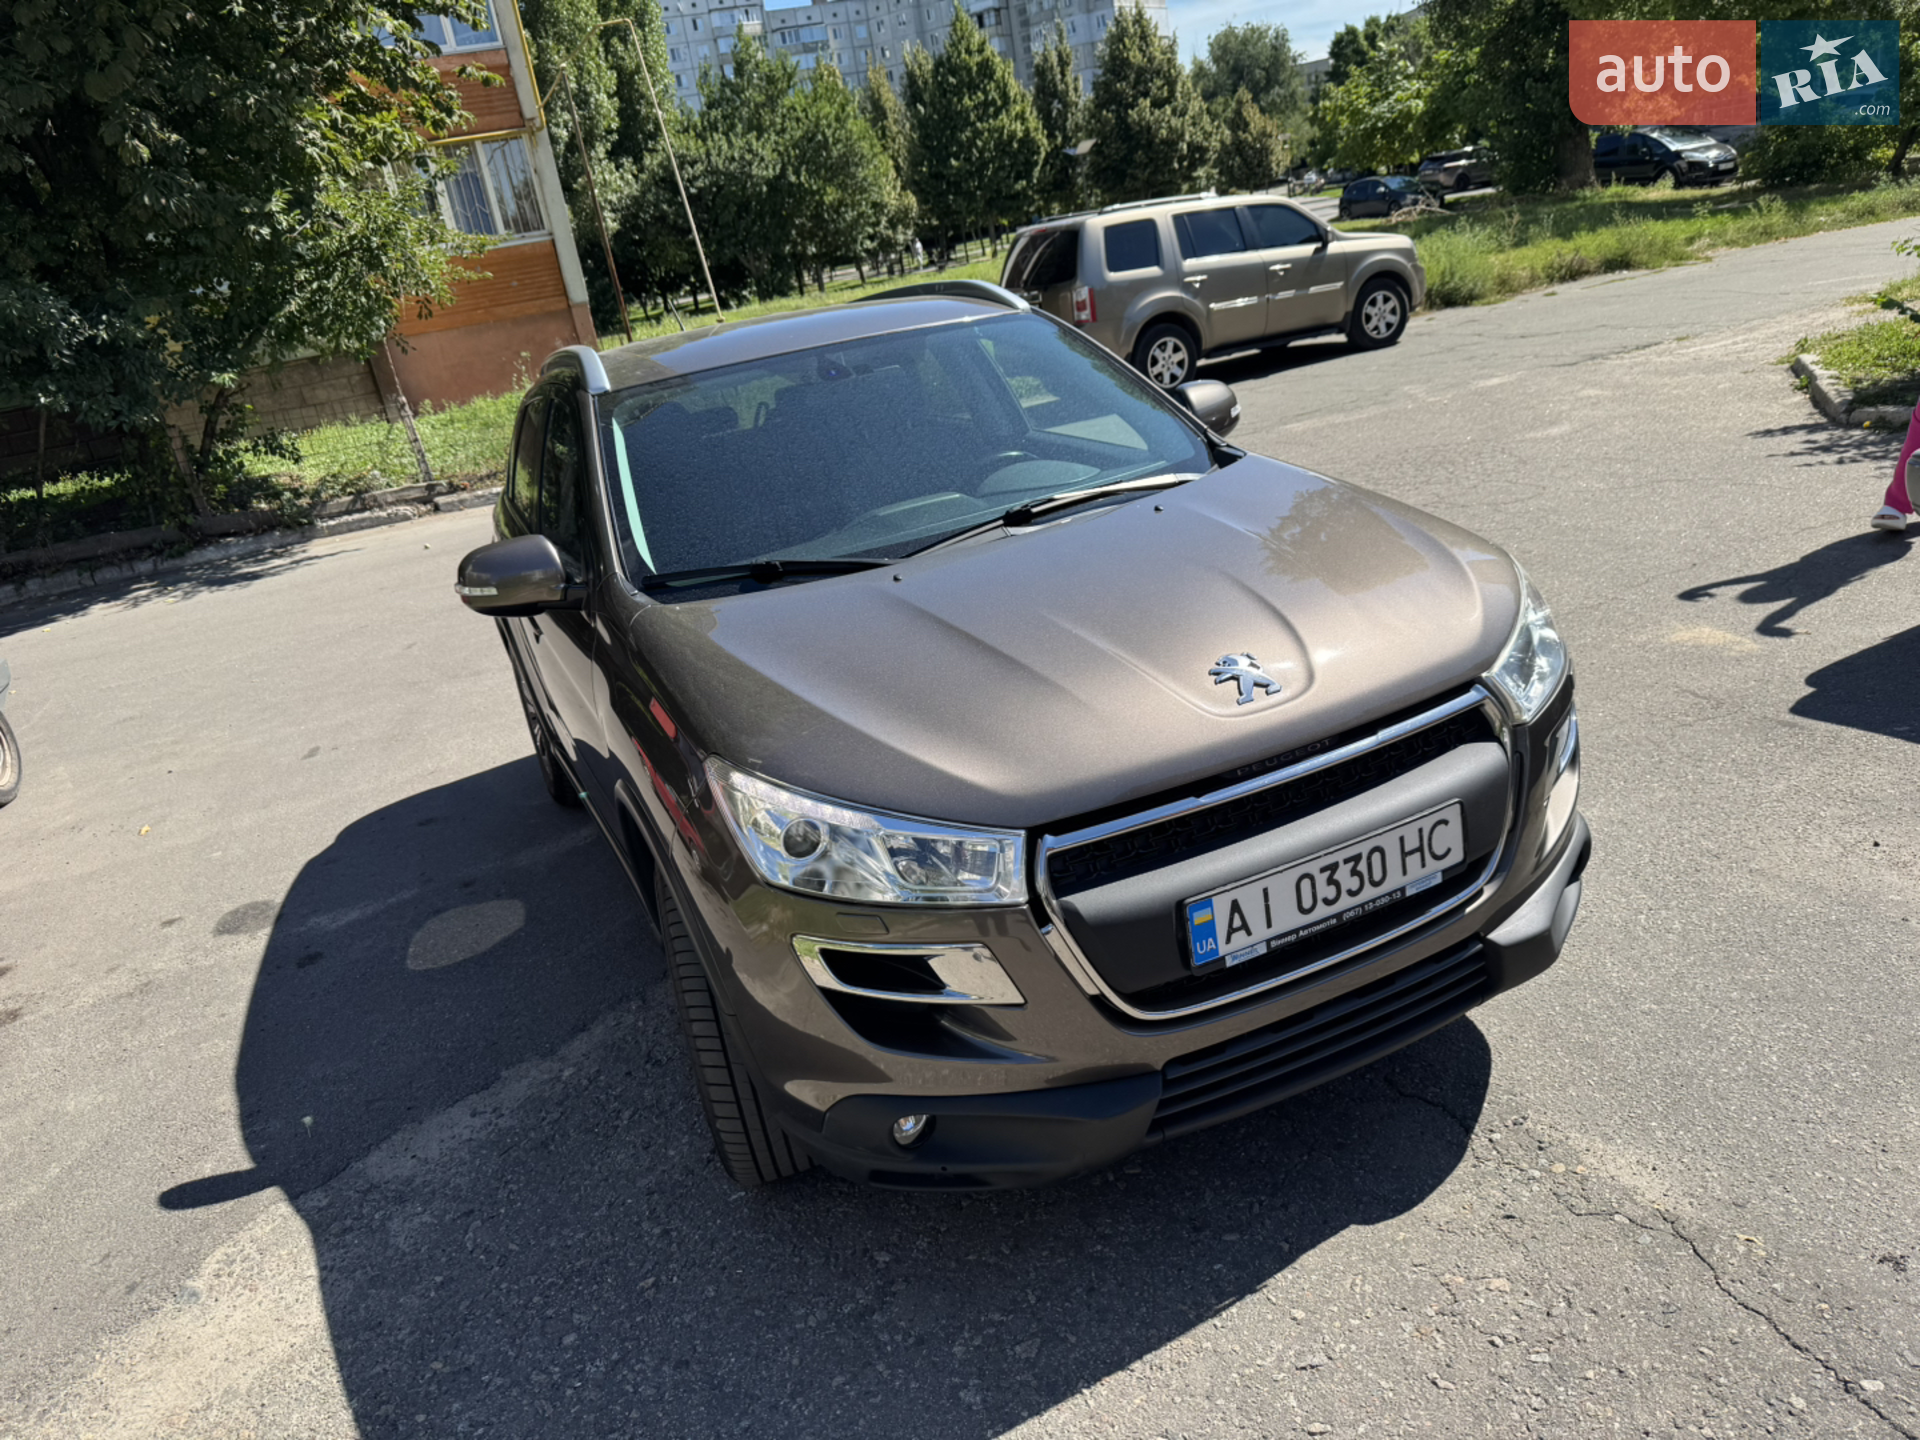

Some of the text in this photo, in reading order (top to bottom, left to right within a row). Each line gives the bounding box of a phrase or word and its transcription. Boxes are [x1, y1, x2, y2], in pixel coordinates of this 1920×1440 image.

[1236, 738, 1332, 777] PEUGEOT
[1224, 818, 1453, 946] AI 0330 HC
[1196, 936, 1217, 955] UA
